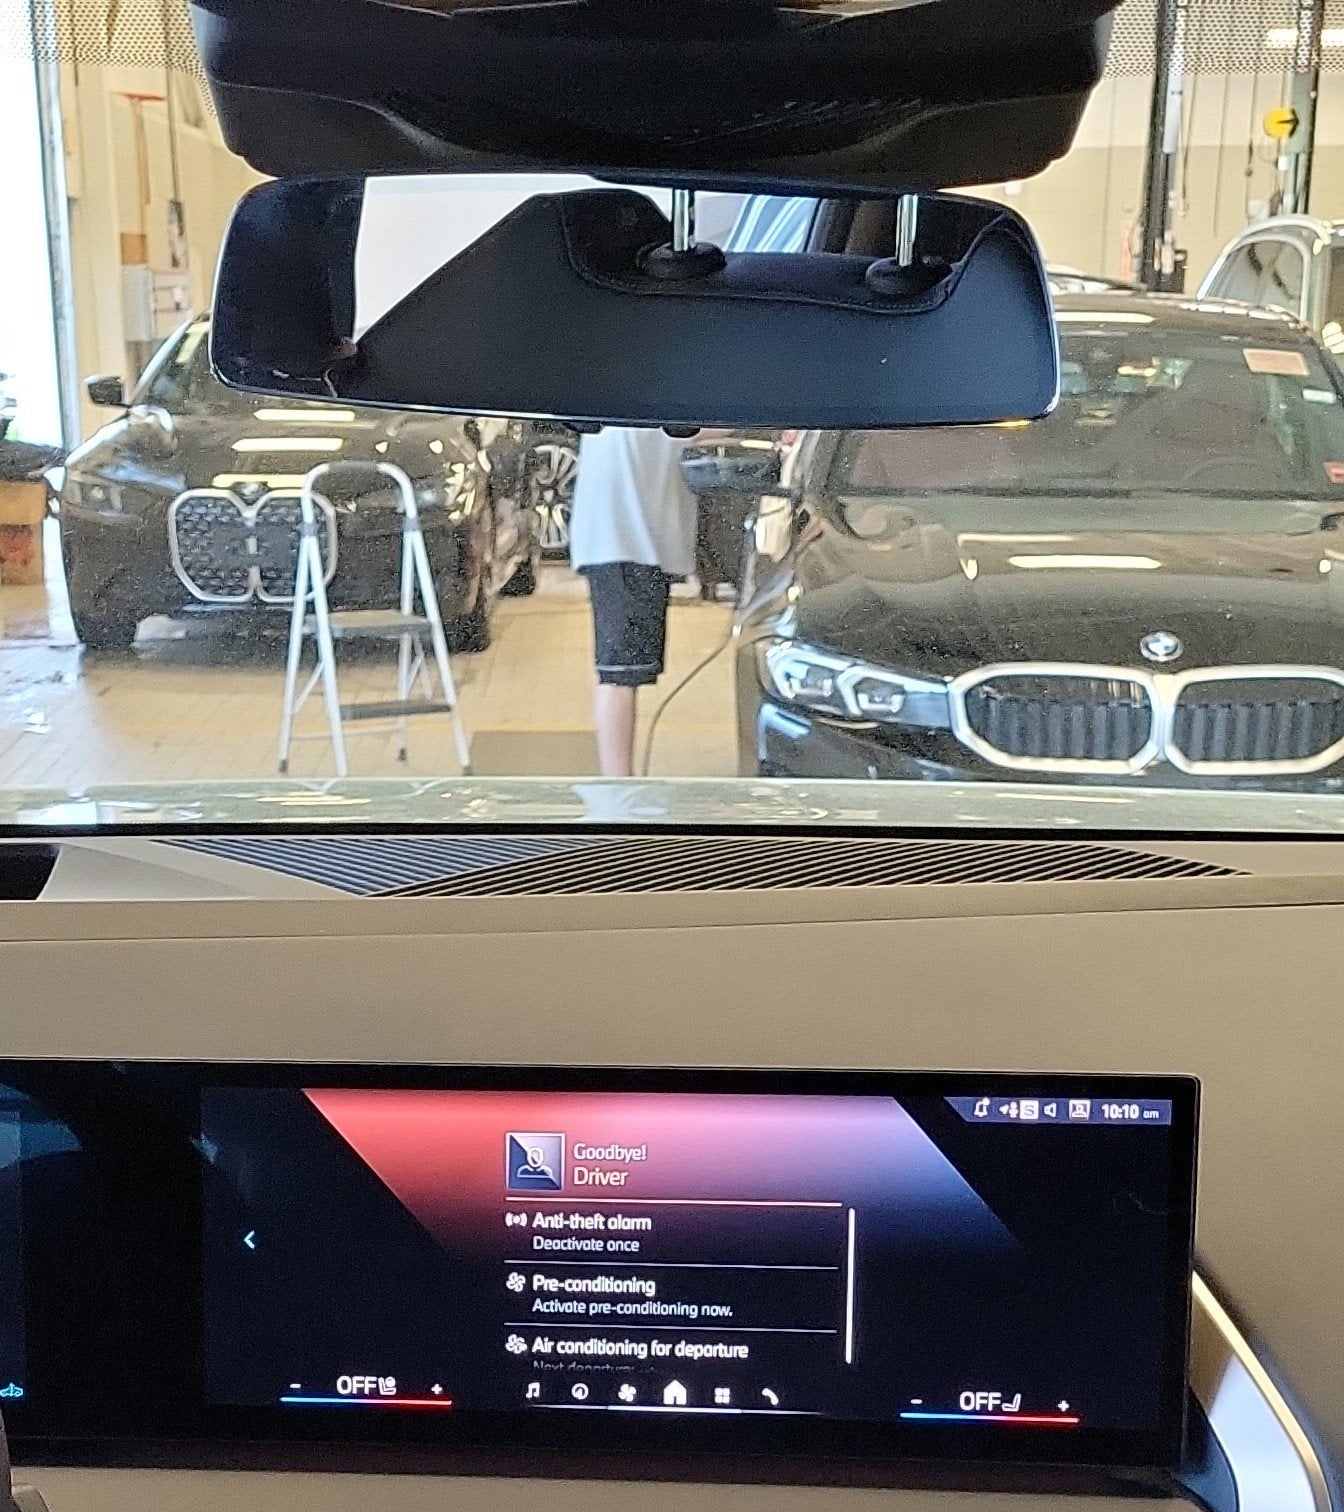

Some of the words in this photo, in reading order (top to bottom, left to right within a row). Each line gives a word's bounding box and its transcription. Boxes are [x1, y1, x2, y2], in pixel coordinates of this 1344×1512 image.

[1102, 1103, 1140, 1120] 10:10
[573, 1143, 648, 1164] Goodbye!
[573, 1167, 629, 1186] Driver
[531, 1212, 606, 1231] Anti-theft
[607, 1213, 653, 1231] alarm
[532, 1235, 604, 1252] Deactivate
[606, 1240, 641, 1252] once
[532, 1274, 656, 1298] Pre-conditioning
[531, 1298, 587, 1314] Activate
[588, 1300, 699, 1318] pre-conditioning
[701, 1304, 734, 1317] now.
[531, 1336, 555, 1353] Air
[556, 1338, 649, 1360] conditioning
[650, 1339, 672, 1356] for
[674, 1341, 750, 1360] departure
[336, 1375, 378, 1395] OFF
[959, 1391, 1002, 1412] OFF
